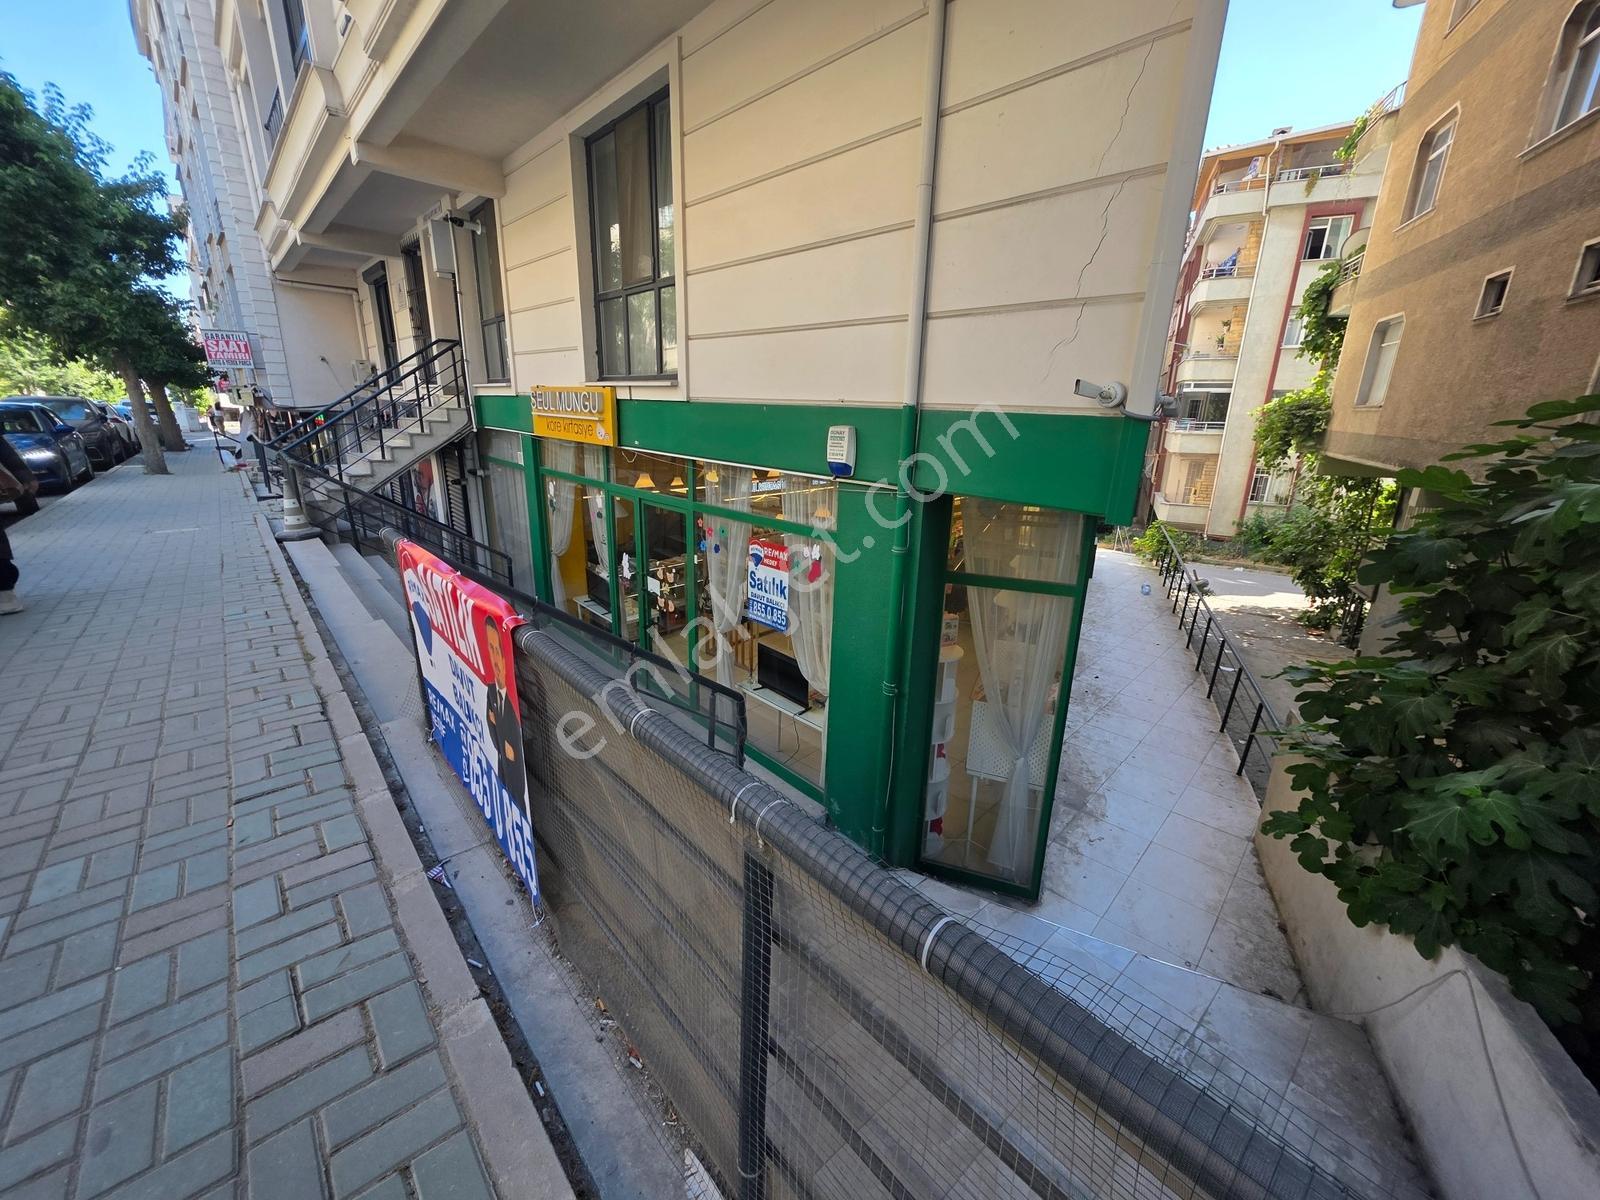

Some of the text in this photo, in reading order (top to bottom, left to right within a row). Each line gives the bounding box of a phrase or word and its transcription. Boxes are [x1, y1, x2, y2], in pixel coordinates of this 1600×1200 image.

[206, 340, 246, 352] SAAT
[530, 391, 599, 414] SEUL MUNGU
[546, 418, 561, 432] kore
[764, 547, 789, 562] RE/MAX
[749, 570, 787, 600] Satılık
[753, 601, 766, 618] 855
[766, 605, 772, 620] 0
[773, 610, 787, 626] 855
[448, 653, 476, 702] DAVUT
[467, 730, 537, 896] 855 0 855
